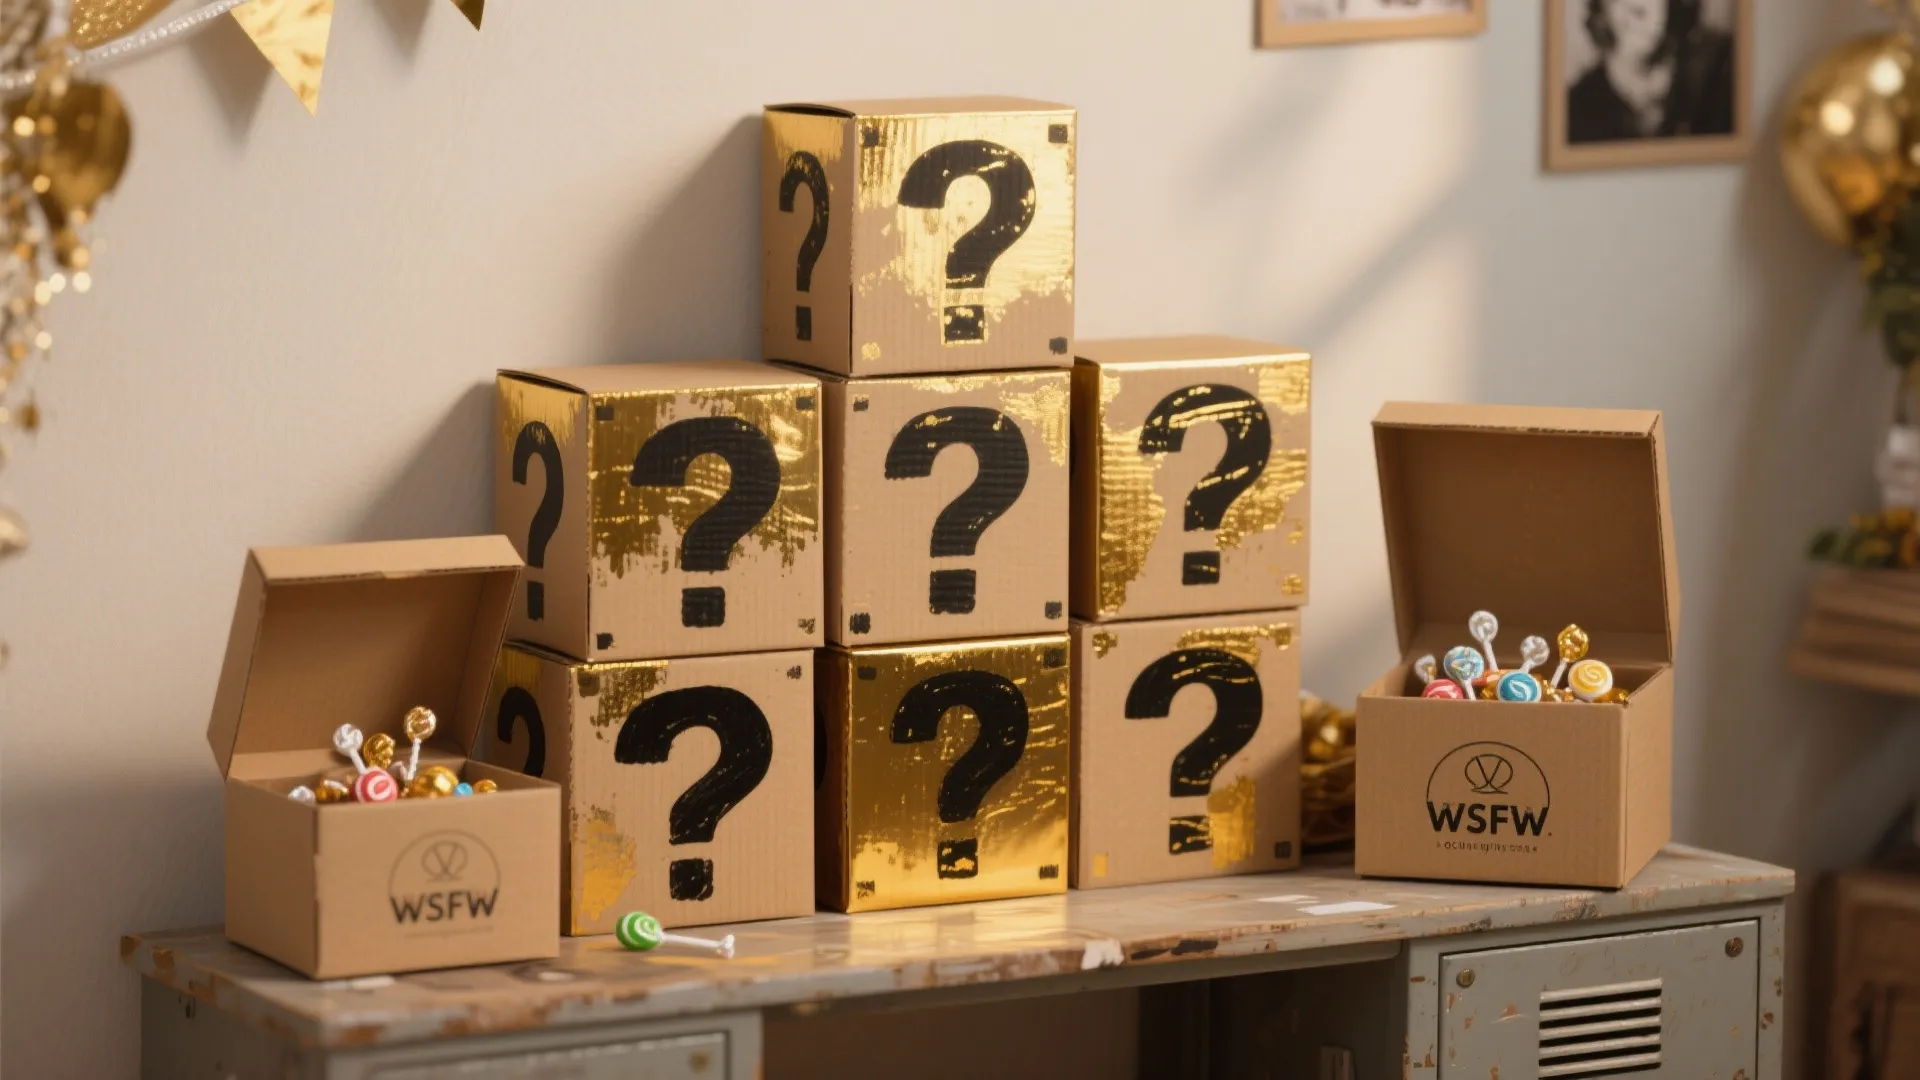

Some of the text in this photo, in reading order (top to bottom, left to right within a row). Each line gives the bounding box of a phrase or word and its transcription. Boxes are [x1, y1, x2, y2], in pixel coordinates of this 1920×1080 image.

[898, 140, 1036, 341] ?
[630, 416, 781, 628] ?
[885, 406, 1030, 614] ?
[1138, 384, 1271, 585] ?
[614, 685, 773, 901] ?
[890, 670, 1029, 879] ?
[1125, 647, 1263, 855] ?
[390, 887, 500, 925] WSFW
